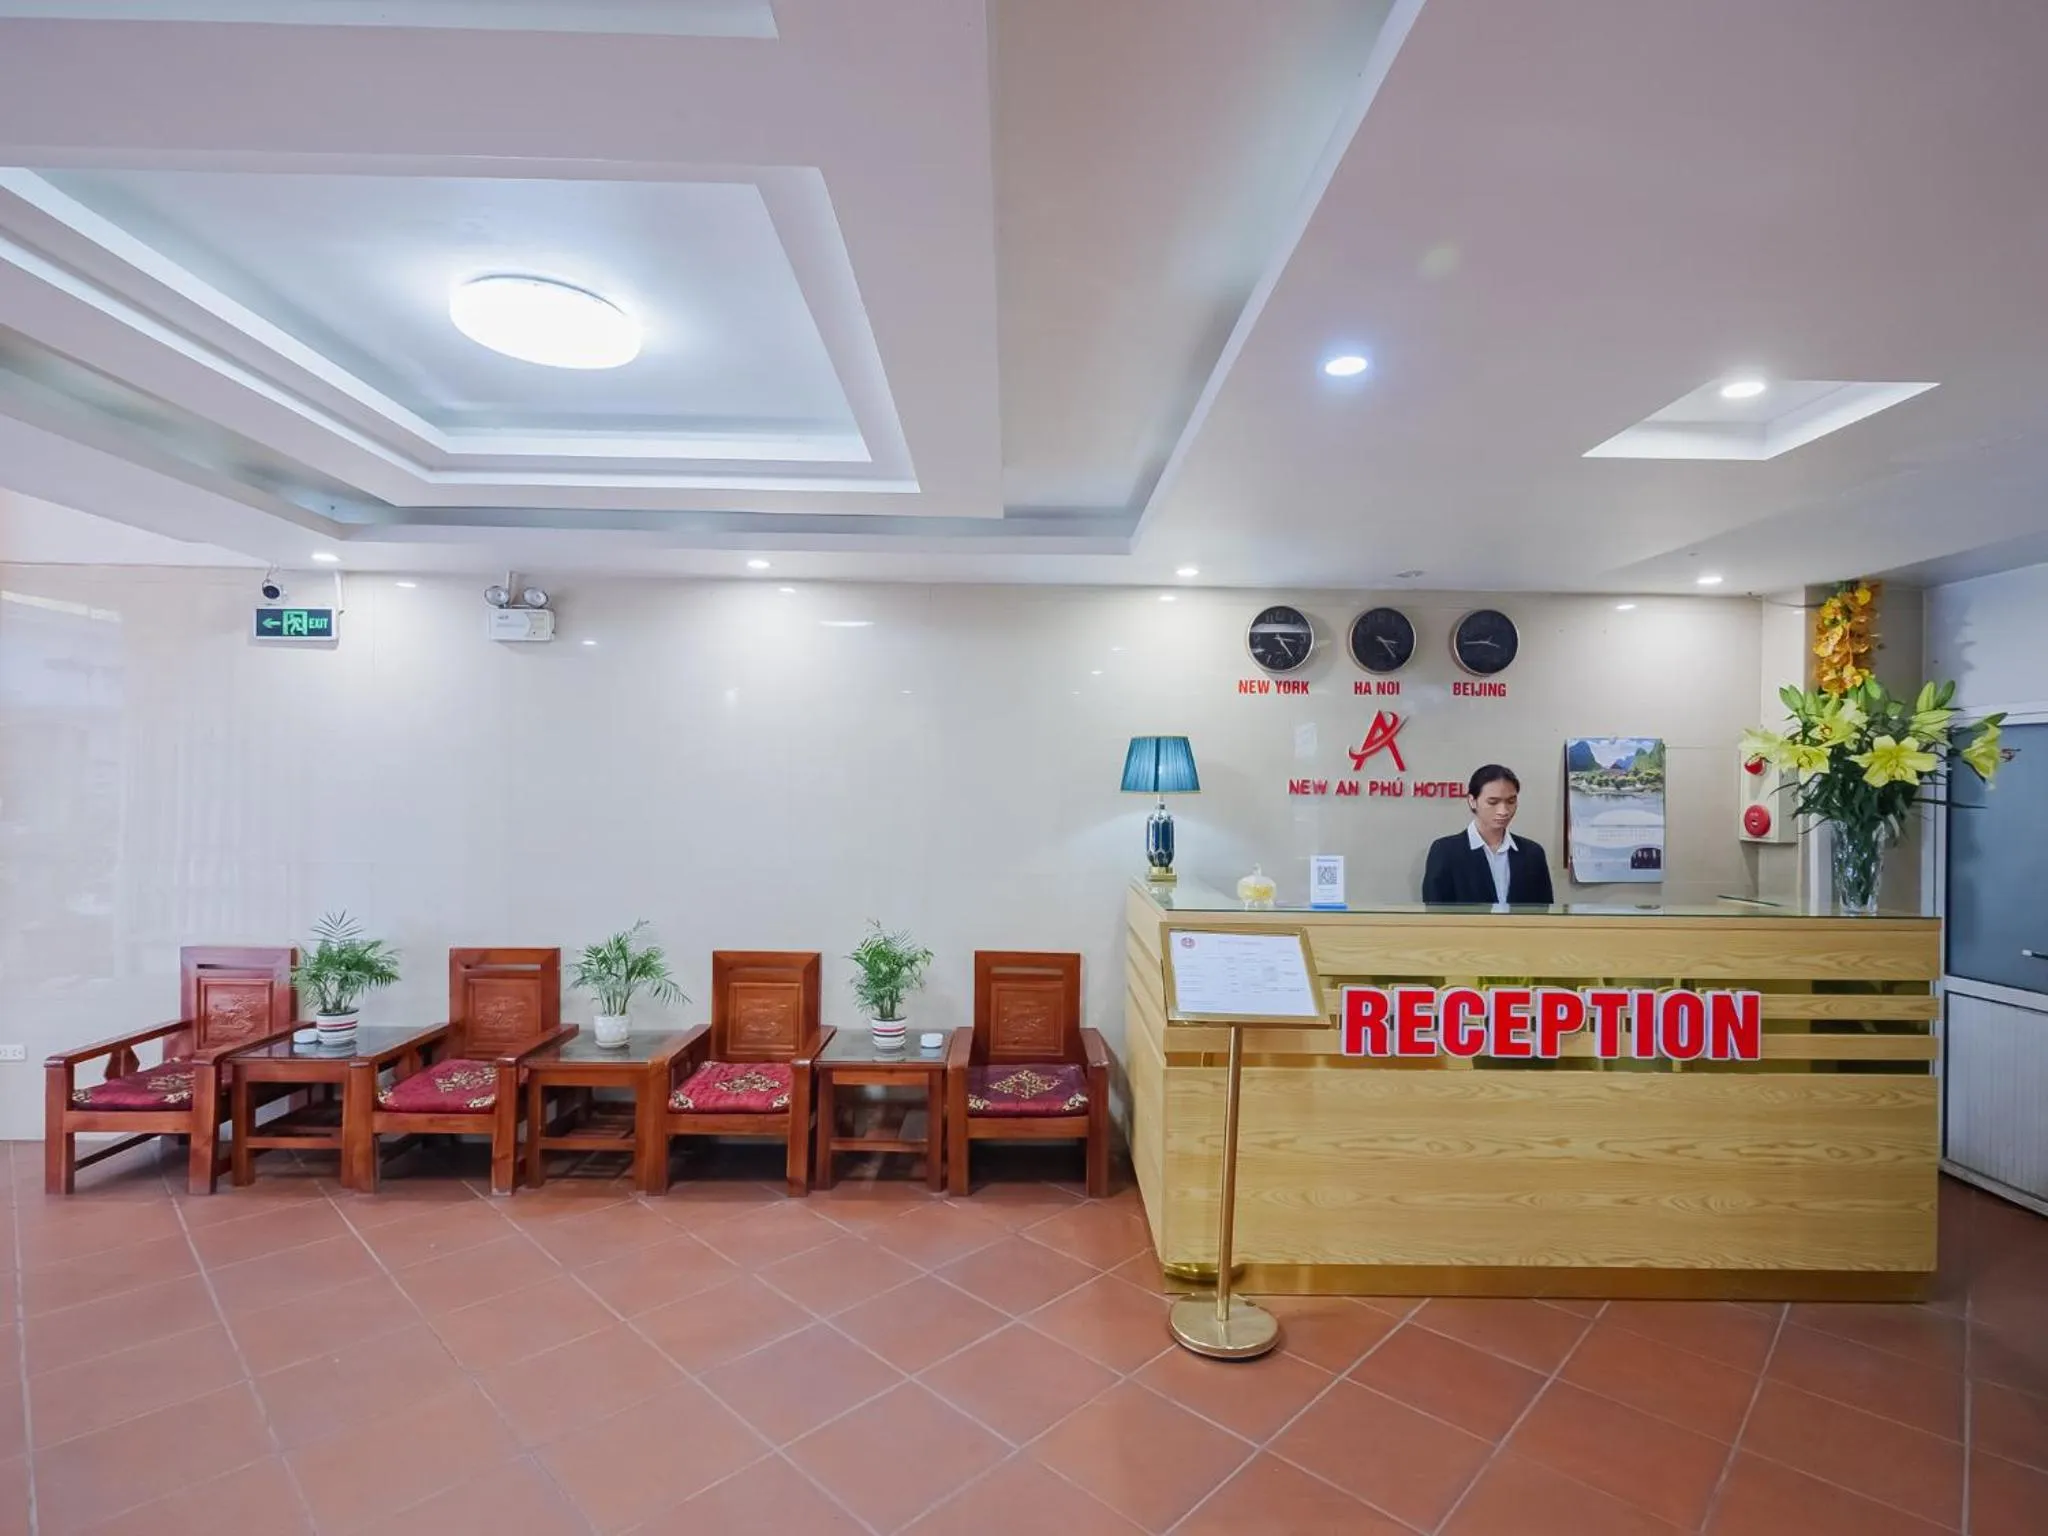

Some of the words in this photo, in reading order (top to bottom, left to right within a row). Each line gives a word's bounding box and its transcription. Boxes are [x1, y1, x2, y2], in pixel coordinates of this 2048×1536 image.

[309, 618, 328, 629] EXIT
[1238, 680, 1270, 694] NEW
[1274, 681, 1309, 695] YORK
[1353, 681, 1372, 695] HA
[1377, 682, 1401, 695] NOI
[1453, 683, 1507, 697] BEIJING
[1288, 779, 1328, 796] NEW
[1336, 780, 1360, 797] AN
[1368, 776, 1403, 798] PHÚ
[1414, 781, 1468, 798] HOTEL
[1341, 984, 1761, 1061] RECEPTION
